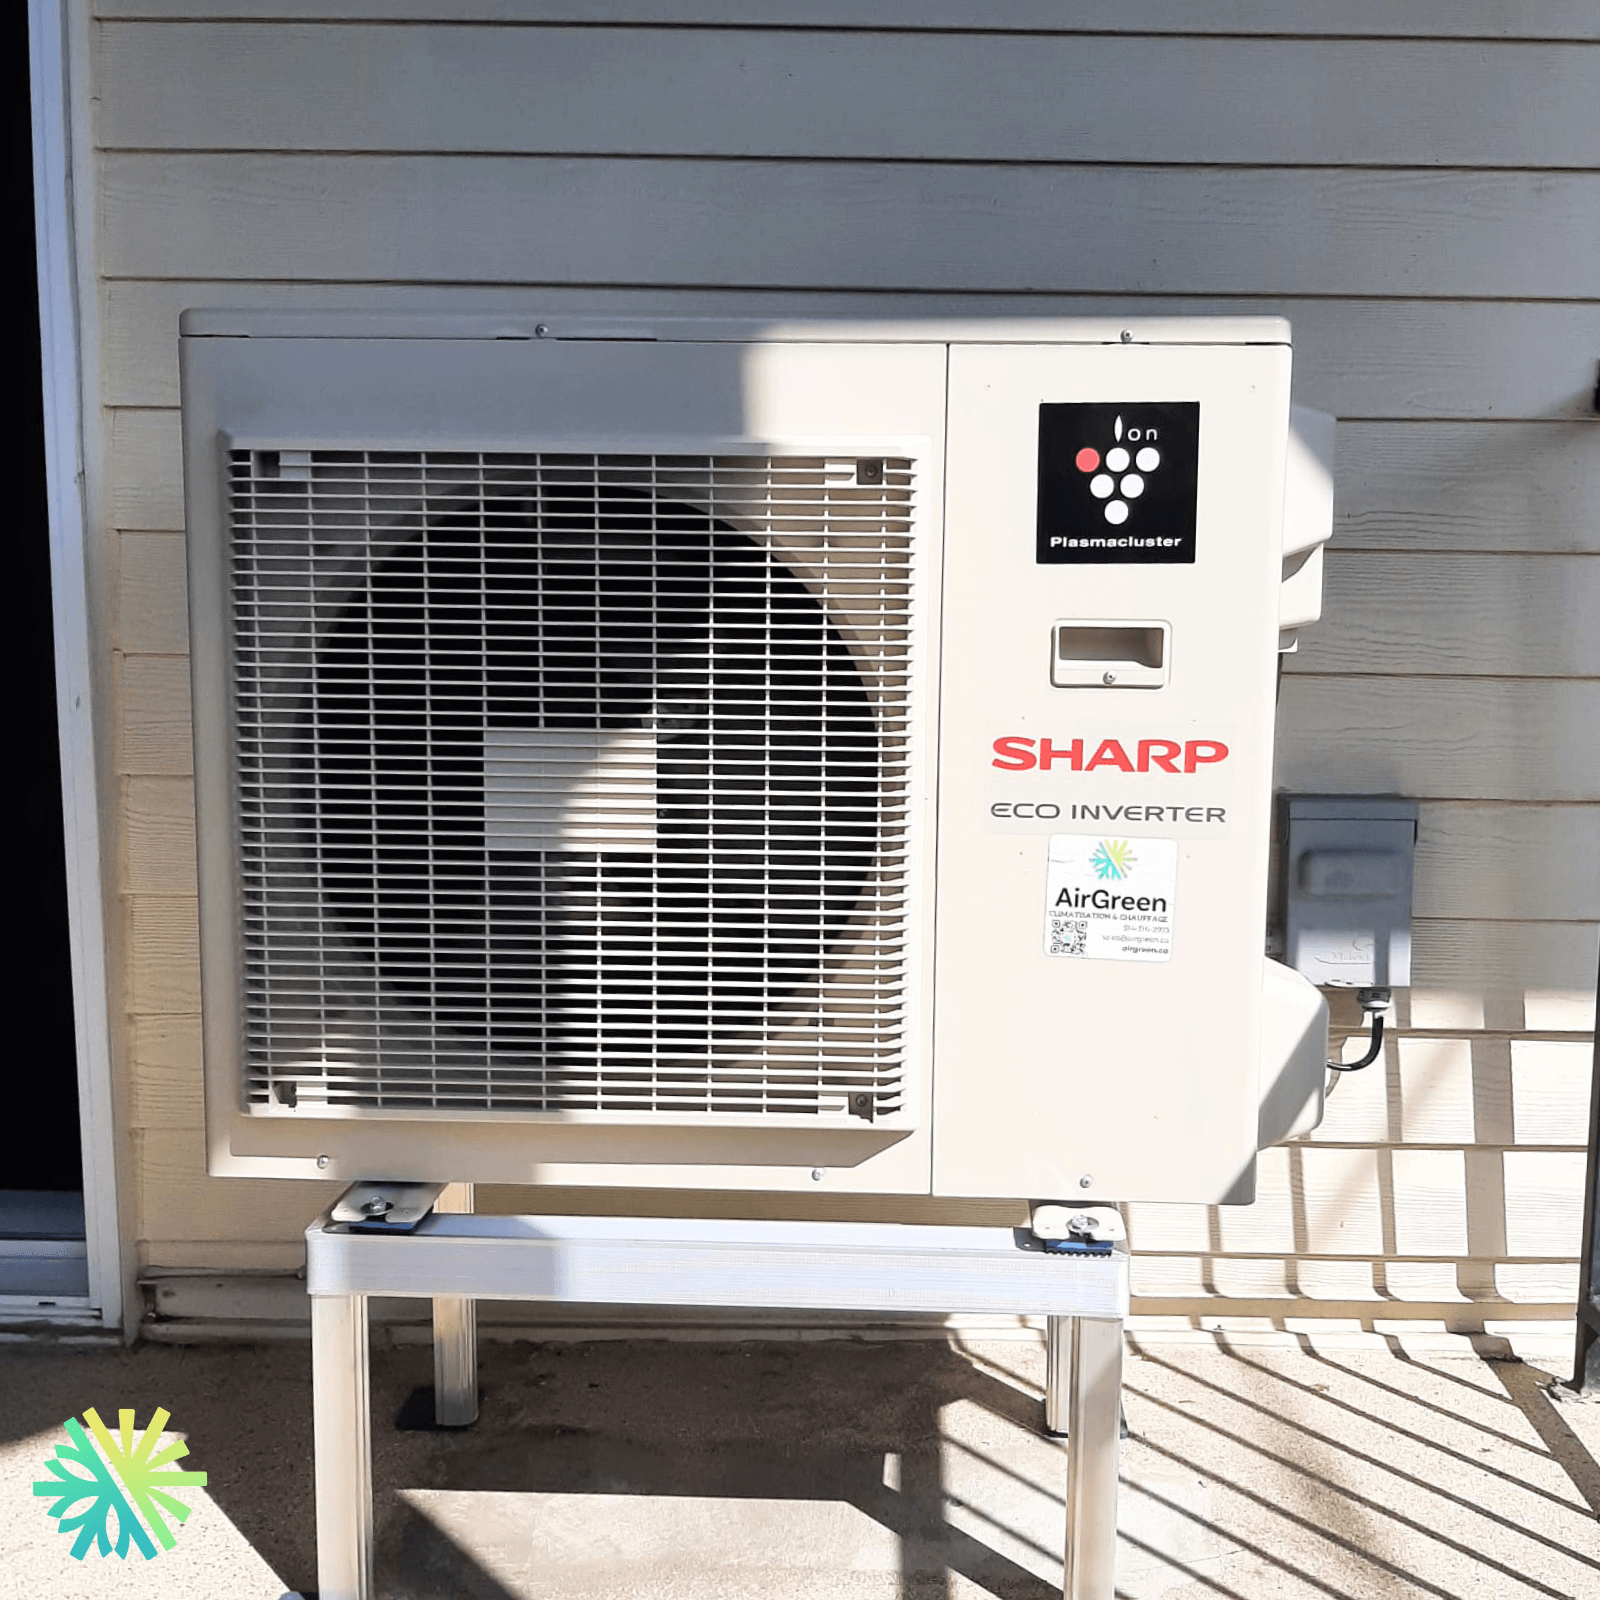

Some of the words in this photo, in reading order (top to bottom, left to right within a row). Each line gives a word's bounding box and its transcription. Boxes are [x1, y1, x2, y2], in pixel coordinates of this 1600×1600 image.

[1114, 414, 1157, 442] Ion
[1050, 535, 1182, 549] Plasmacluster
[991, 736, 1229, 774] SHARP
[991, 802, 1060, 819] ECO
[1072, 804, 1226, 823] INVERTER
[1055, 887, 1167, 912] AirGreen
[1048, 910, 1111, 920] CLIMATISATION
[1119, 914, 1168, 923] CHAUFFAGE
[1122, 945, 1169, 955] airgreen.ca
